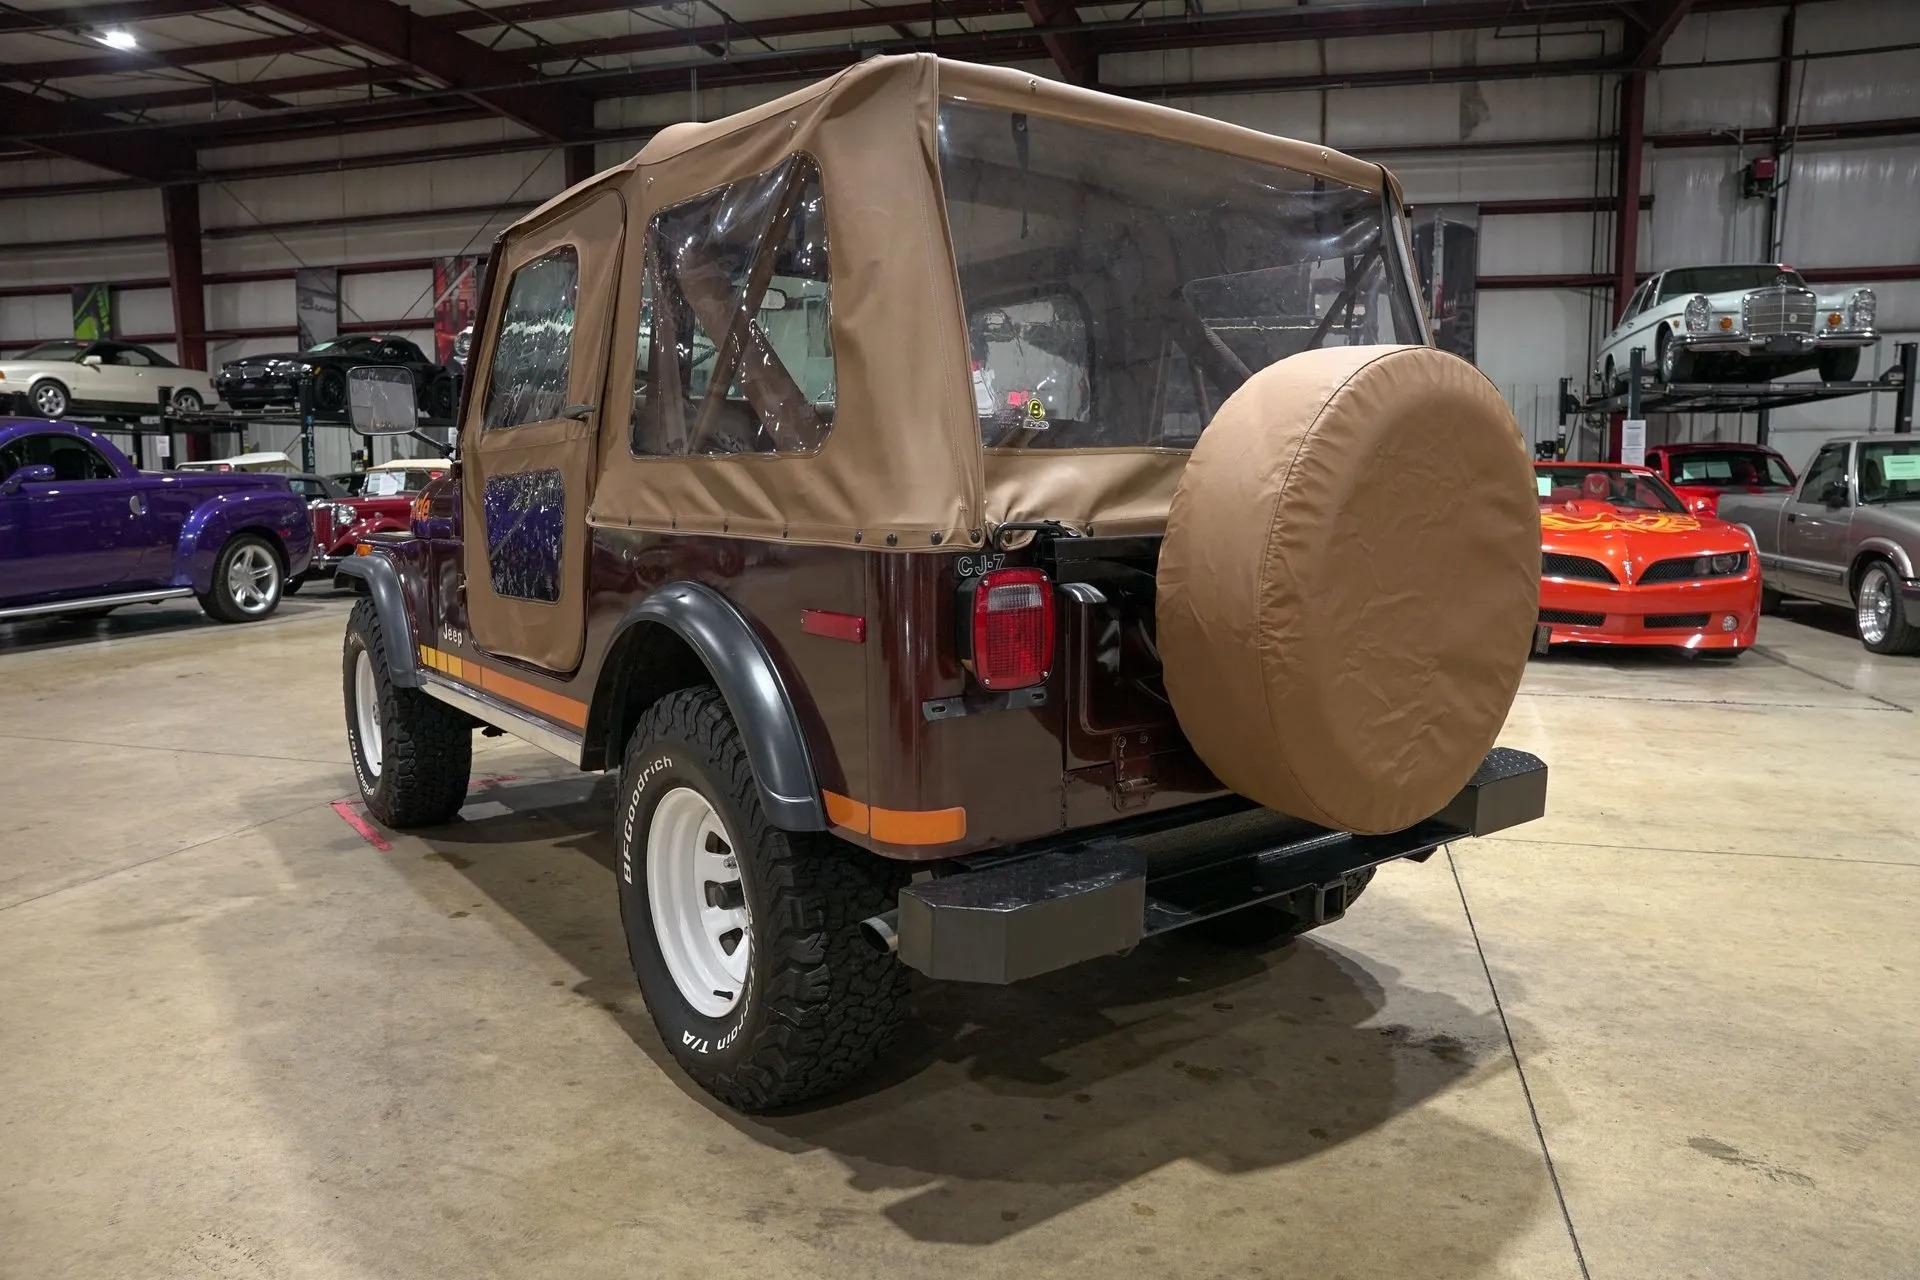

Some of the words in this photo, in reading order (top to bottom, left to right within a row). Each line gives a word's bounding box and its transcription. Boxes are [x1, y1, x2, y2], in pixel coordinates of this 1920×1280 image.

[443, 622, 463, 648] Jeep
[623, 756, 673, 885] BFGoodrich
[681, 1030, 709, 1054] T/A
